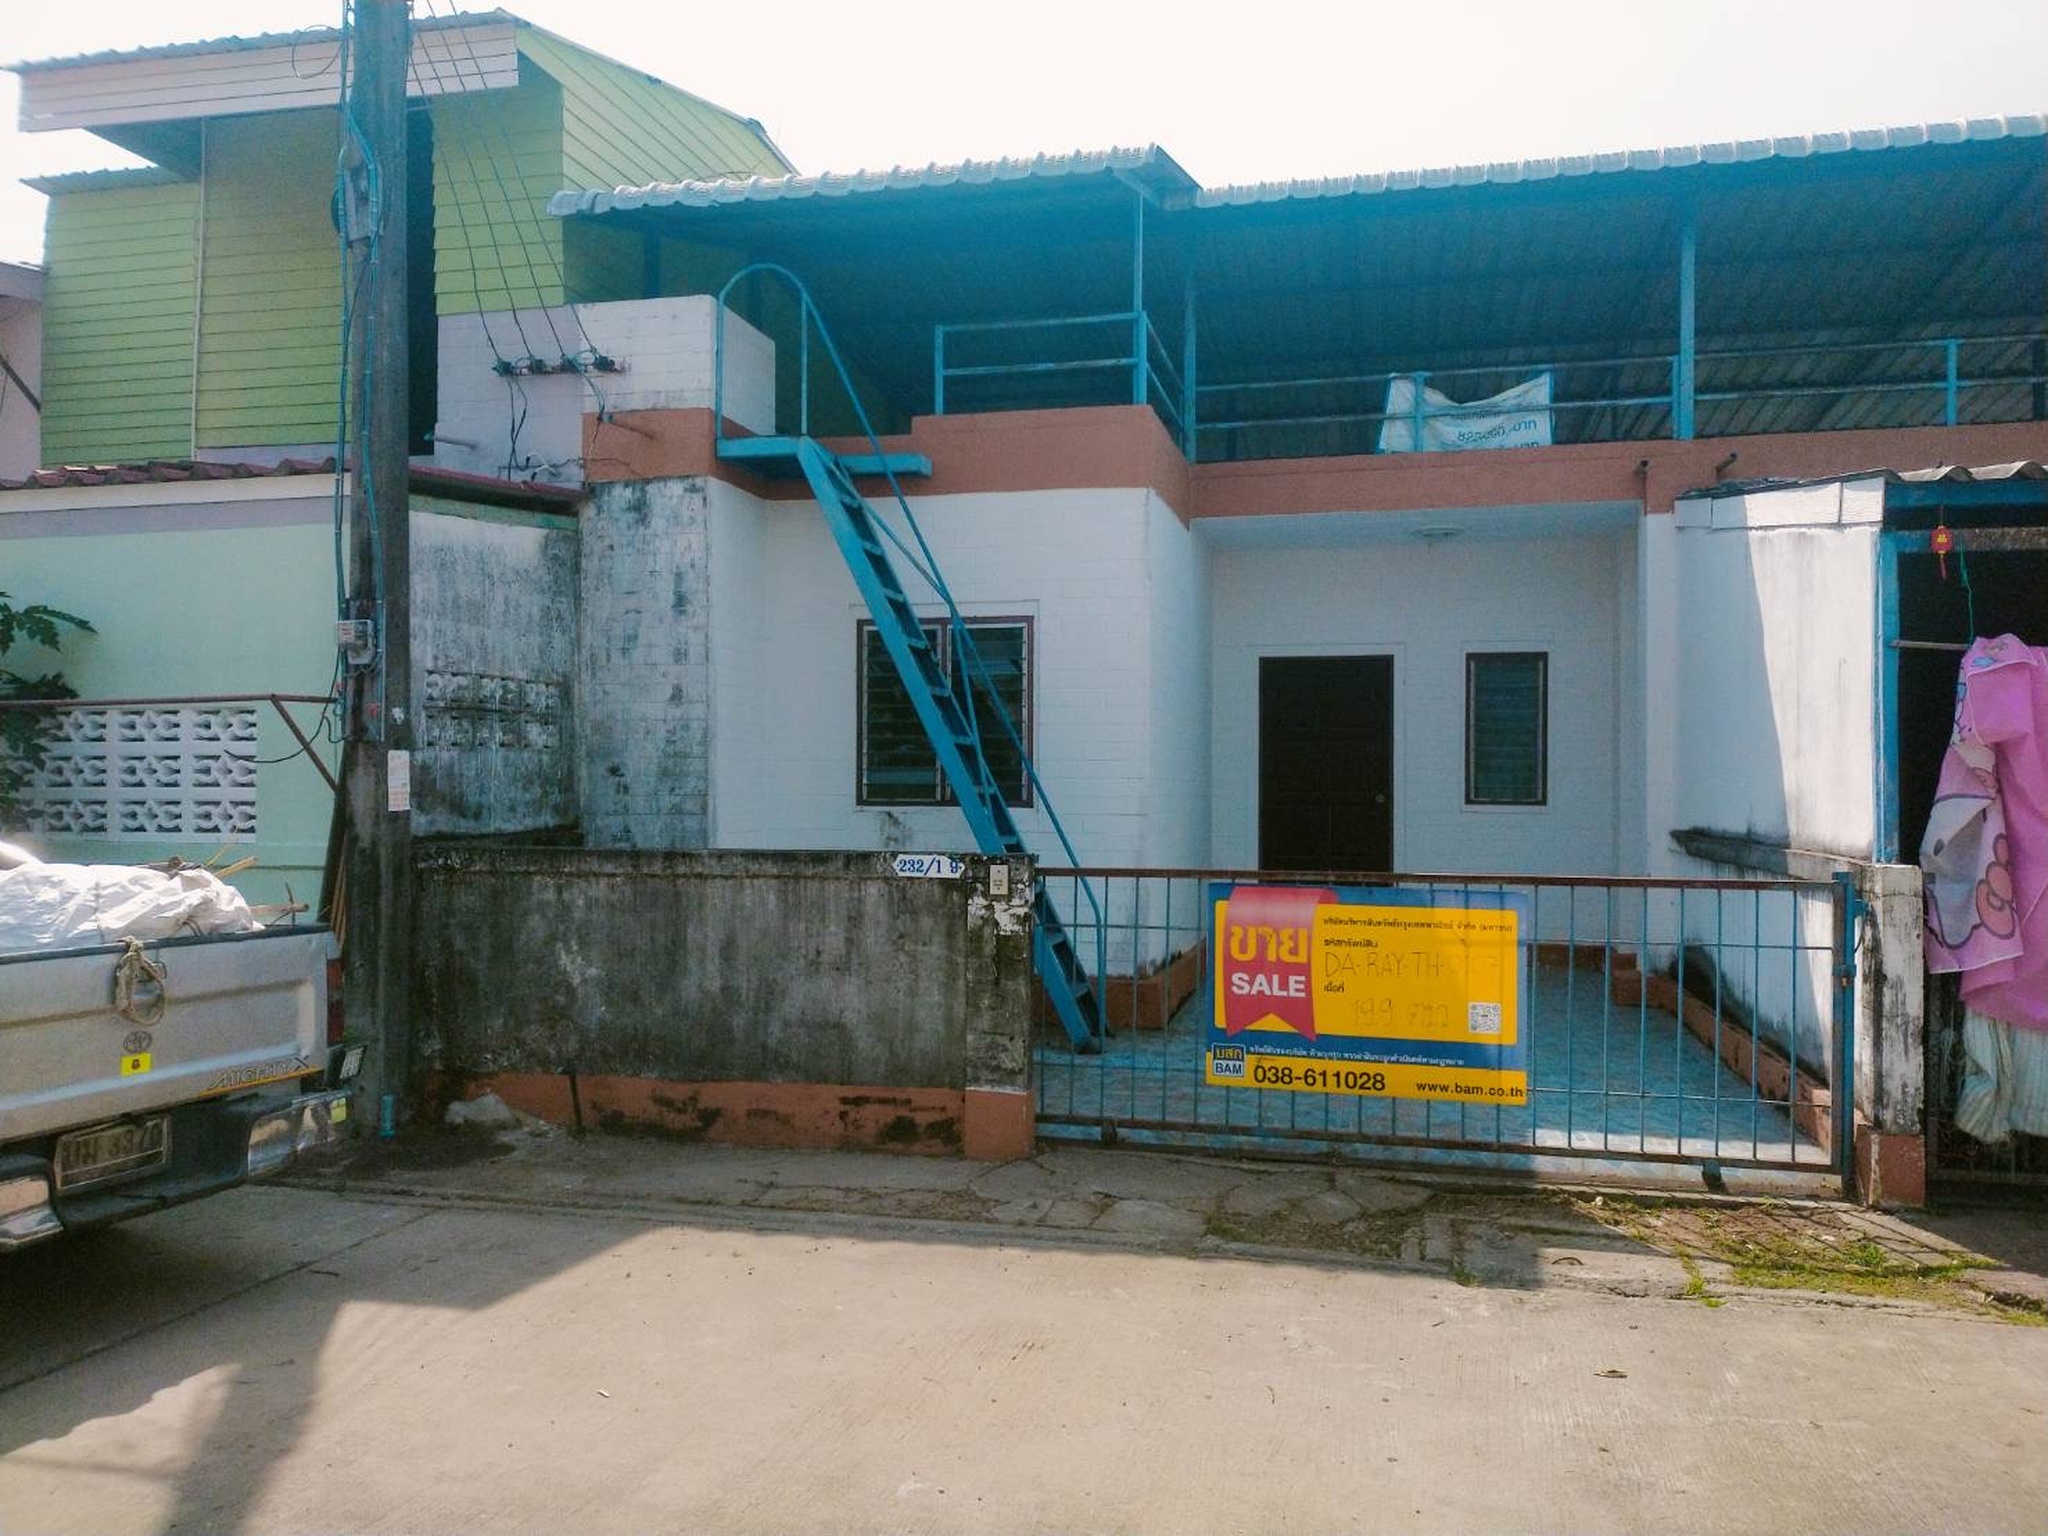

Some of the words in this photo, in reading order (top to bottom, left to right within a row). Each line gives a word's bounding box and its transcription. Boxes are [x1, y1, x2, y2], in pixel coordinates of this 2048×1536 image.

[1230, 924, 1309, 964] ขาย
[1231, 972, 1307, 998] SALE
[1215, 1062, 1242, 1076] BAM
[1253, 1065, 1386, 1092] 038-611028
[1416, 1082, 1524, 1098] www.bam.co.th
